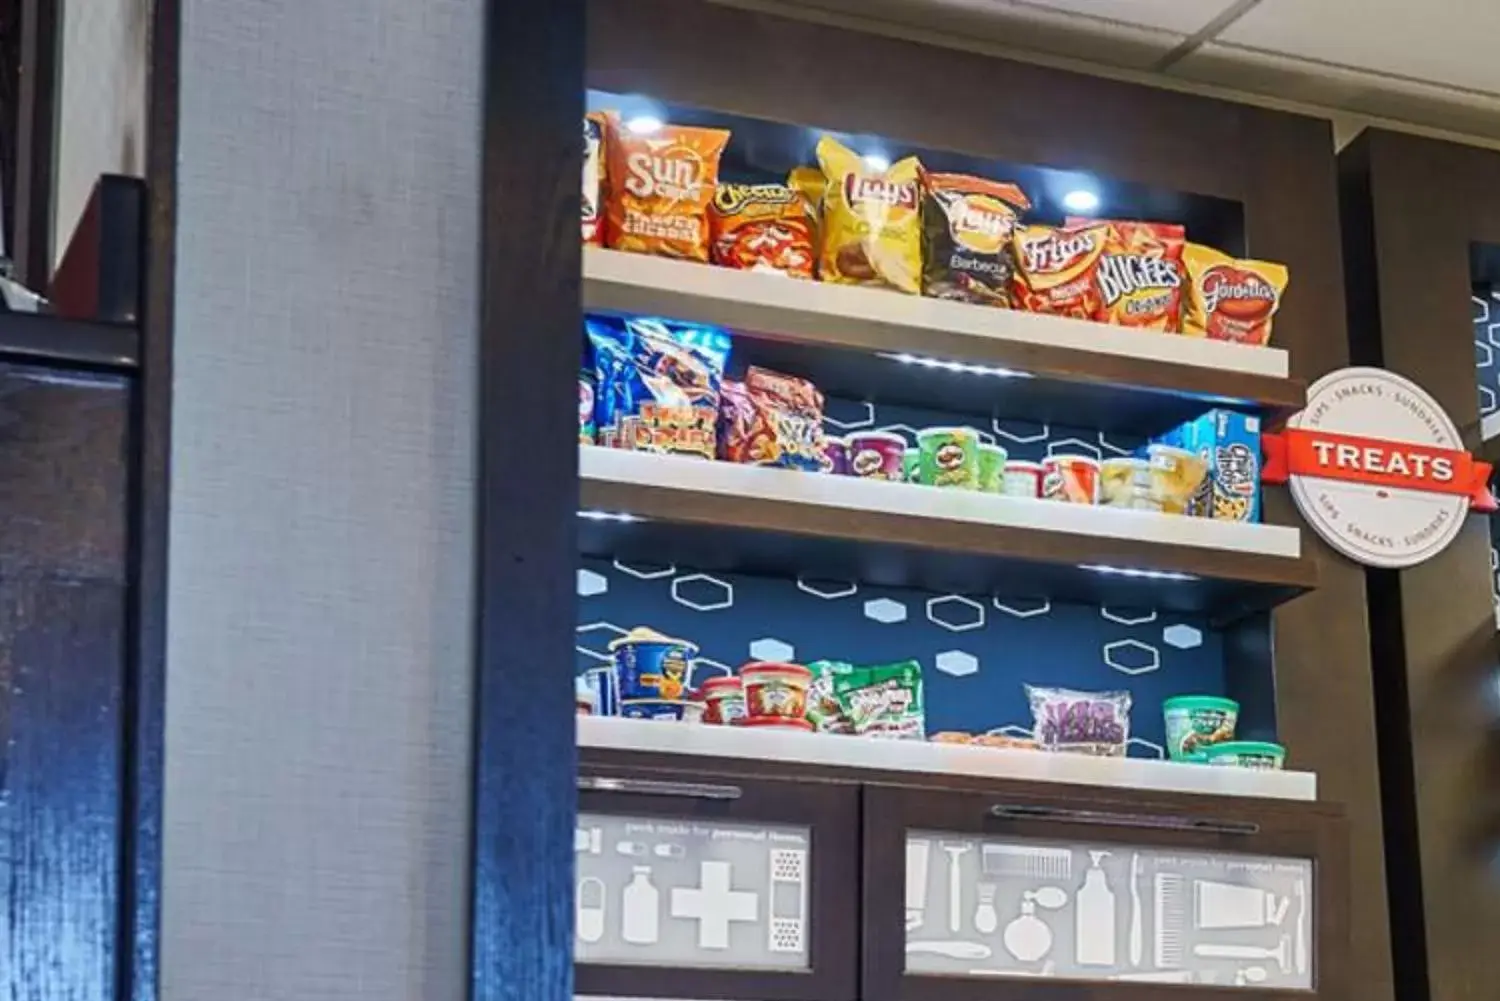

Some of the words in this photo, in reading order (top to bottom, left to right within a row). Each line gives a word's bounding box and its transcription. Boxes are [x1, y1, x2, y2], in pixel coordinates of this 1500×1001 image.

[624, 152, 695, 197] Sun
[1022, 233, 1096, 273] Fritos
[1311, 440, 1454, 482] TREATS
